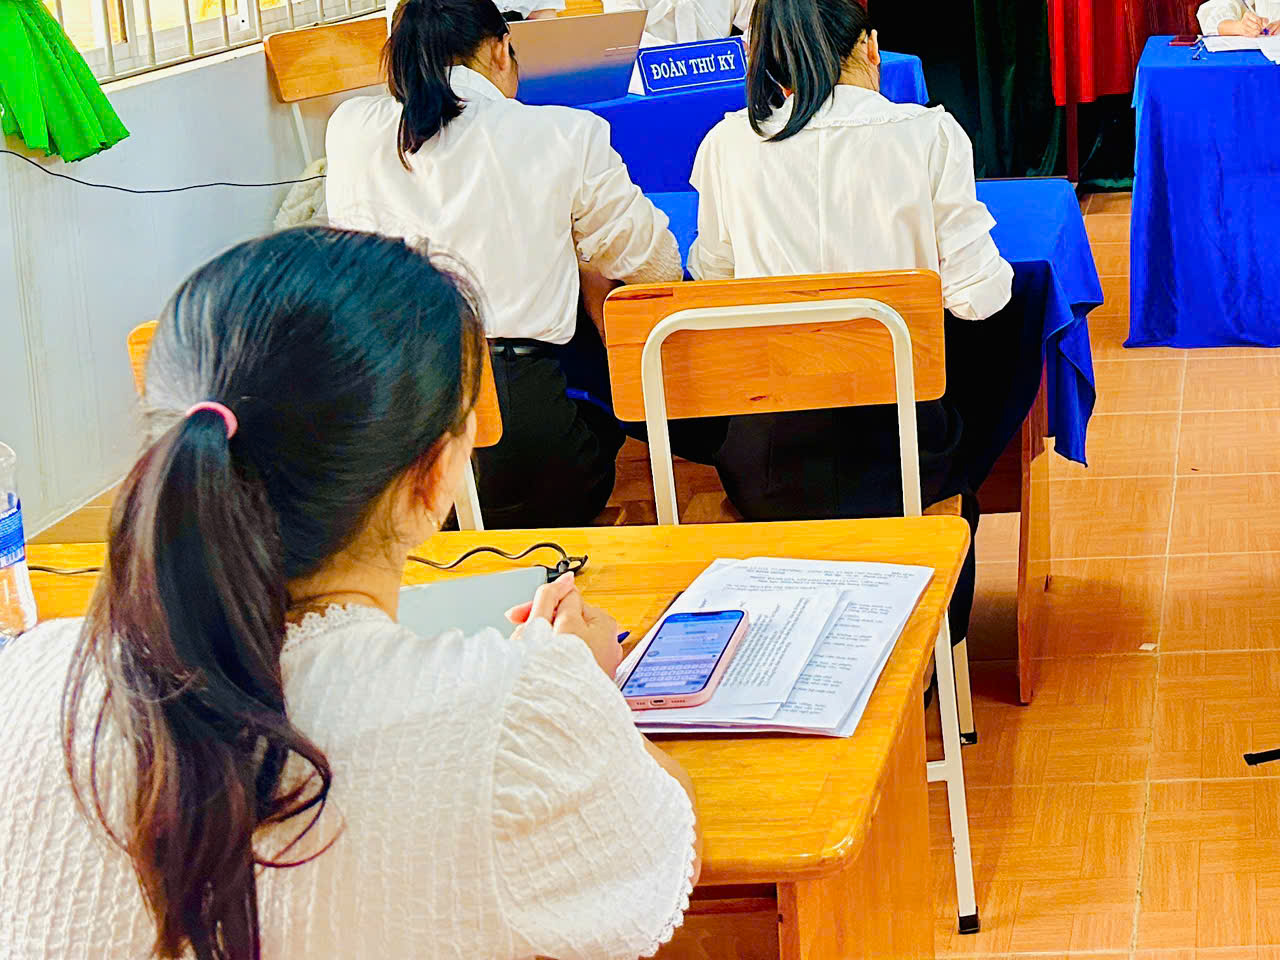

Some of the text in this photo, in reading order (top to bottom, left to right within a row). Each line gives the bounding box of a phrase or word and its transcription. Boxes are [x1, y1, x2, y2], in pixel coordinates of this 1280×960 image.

[650, 50, 736, 80] ĐOÀN THƯ KÝ
